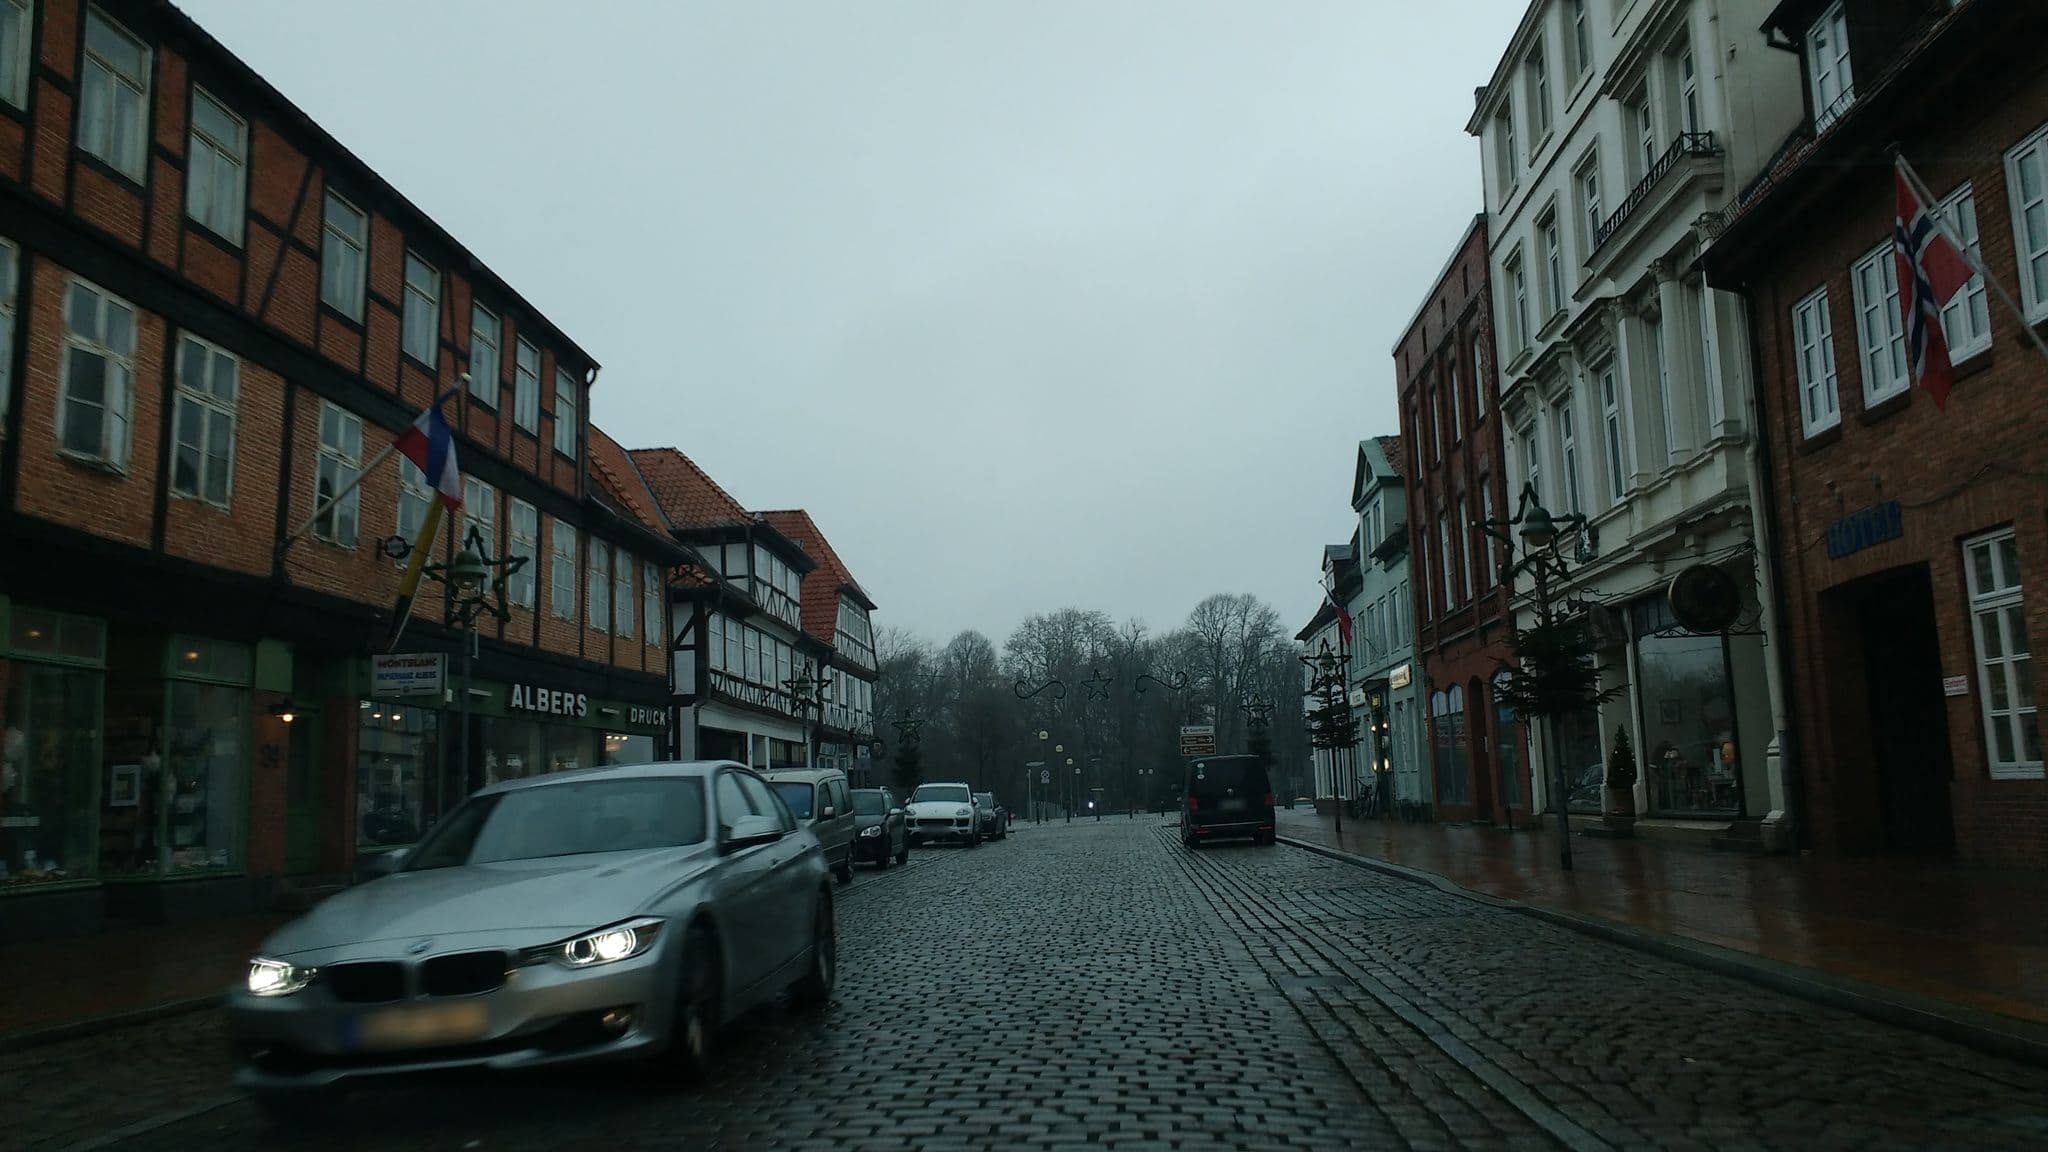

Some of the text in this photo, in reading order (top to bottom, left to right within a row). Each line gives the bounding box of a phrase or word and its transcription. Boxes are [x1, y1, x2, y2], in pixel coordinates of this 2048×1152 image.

[1827, 503, 1900, 556] HOTEL
[510, 683, 666, 727] ALBERS DRUCK
